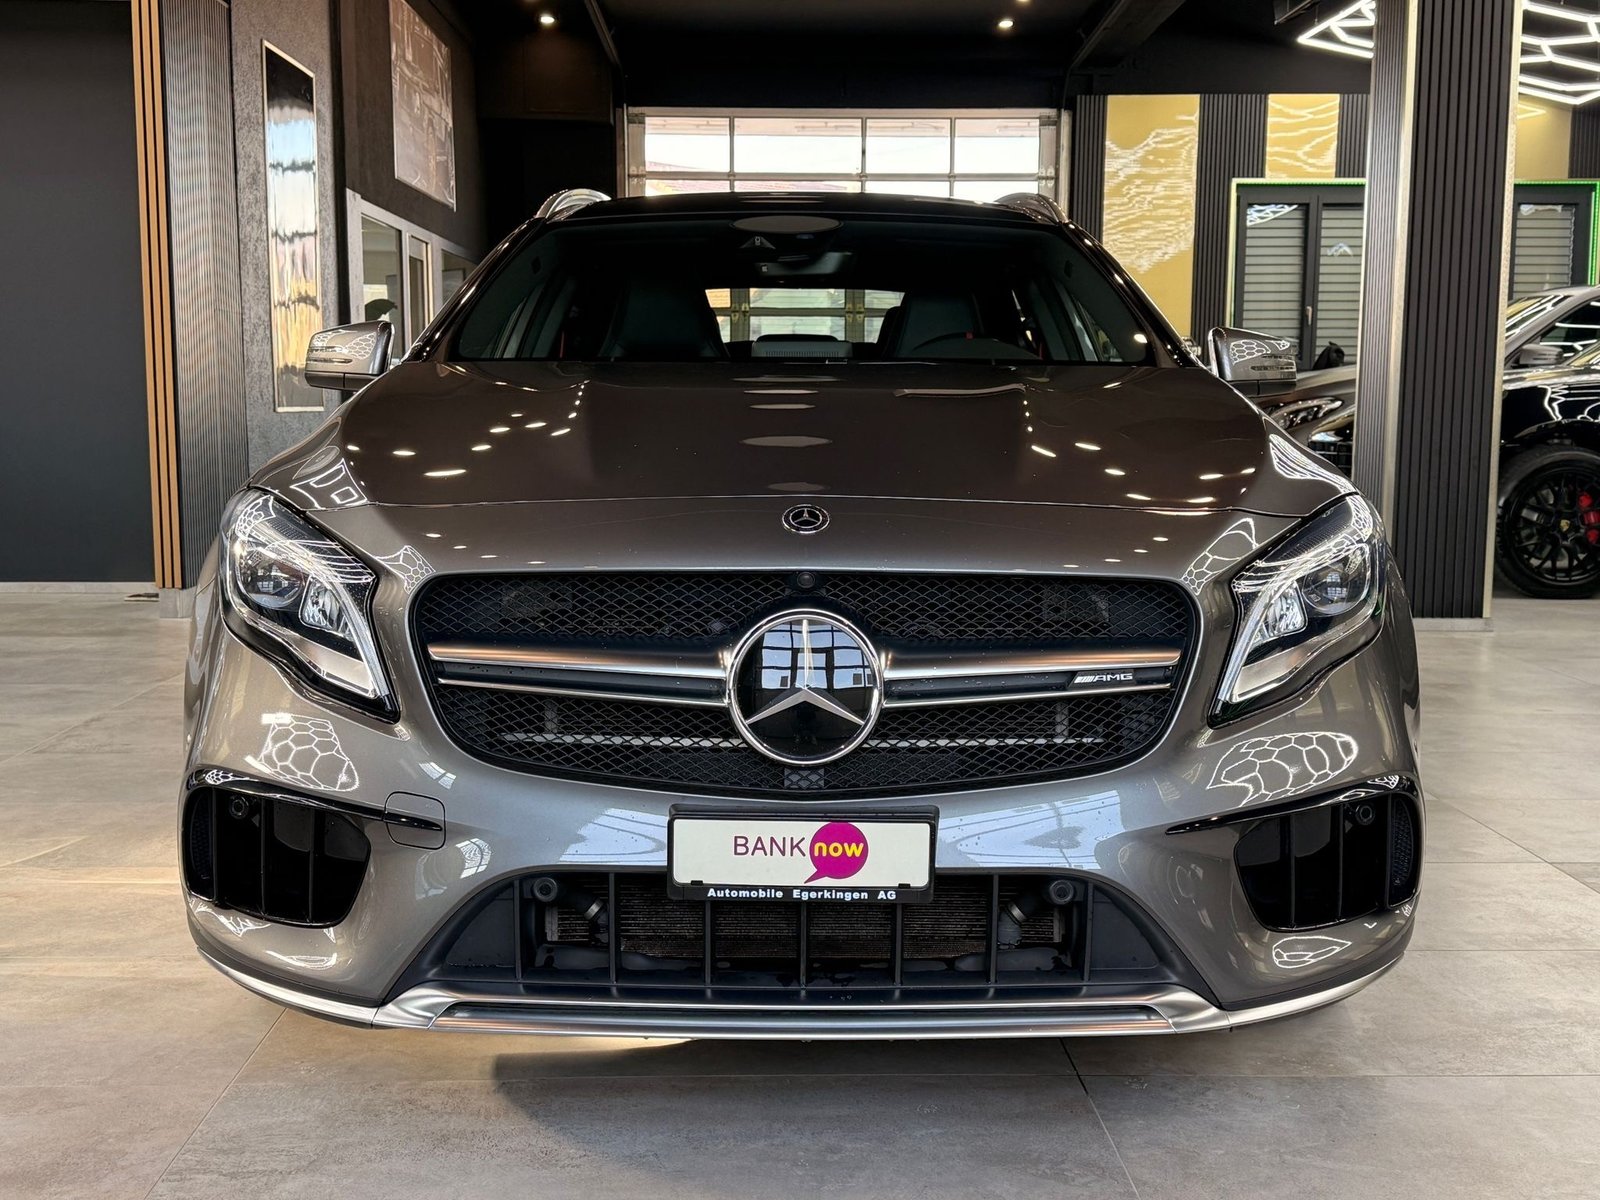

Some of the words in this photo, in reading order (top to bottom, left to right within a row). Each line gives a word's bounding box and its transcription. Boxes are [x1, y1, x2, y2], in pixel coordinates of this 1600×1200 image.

[1092, 673, 1133, 683] AMG
[733, 835, 806, 857] BANK
[813, 841, 864, 857] now
[707, 888, 784, 899] Automobile
[792, 889, 868, 901] Egerkingen
[877, 890, 897, 900] AG
